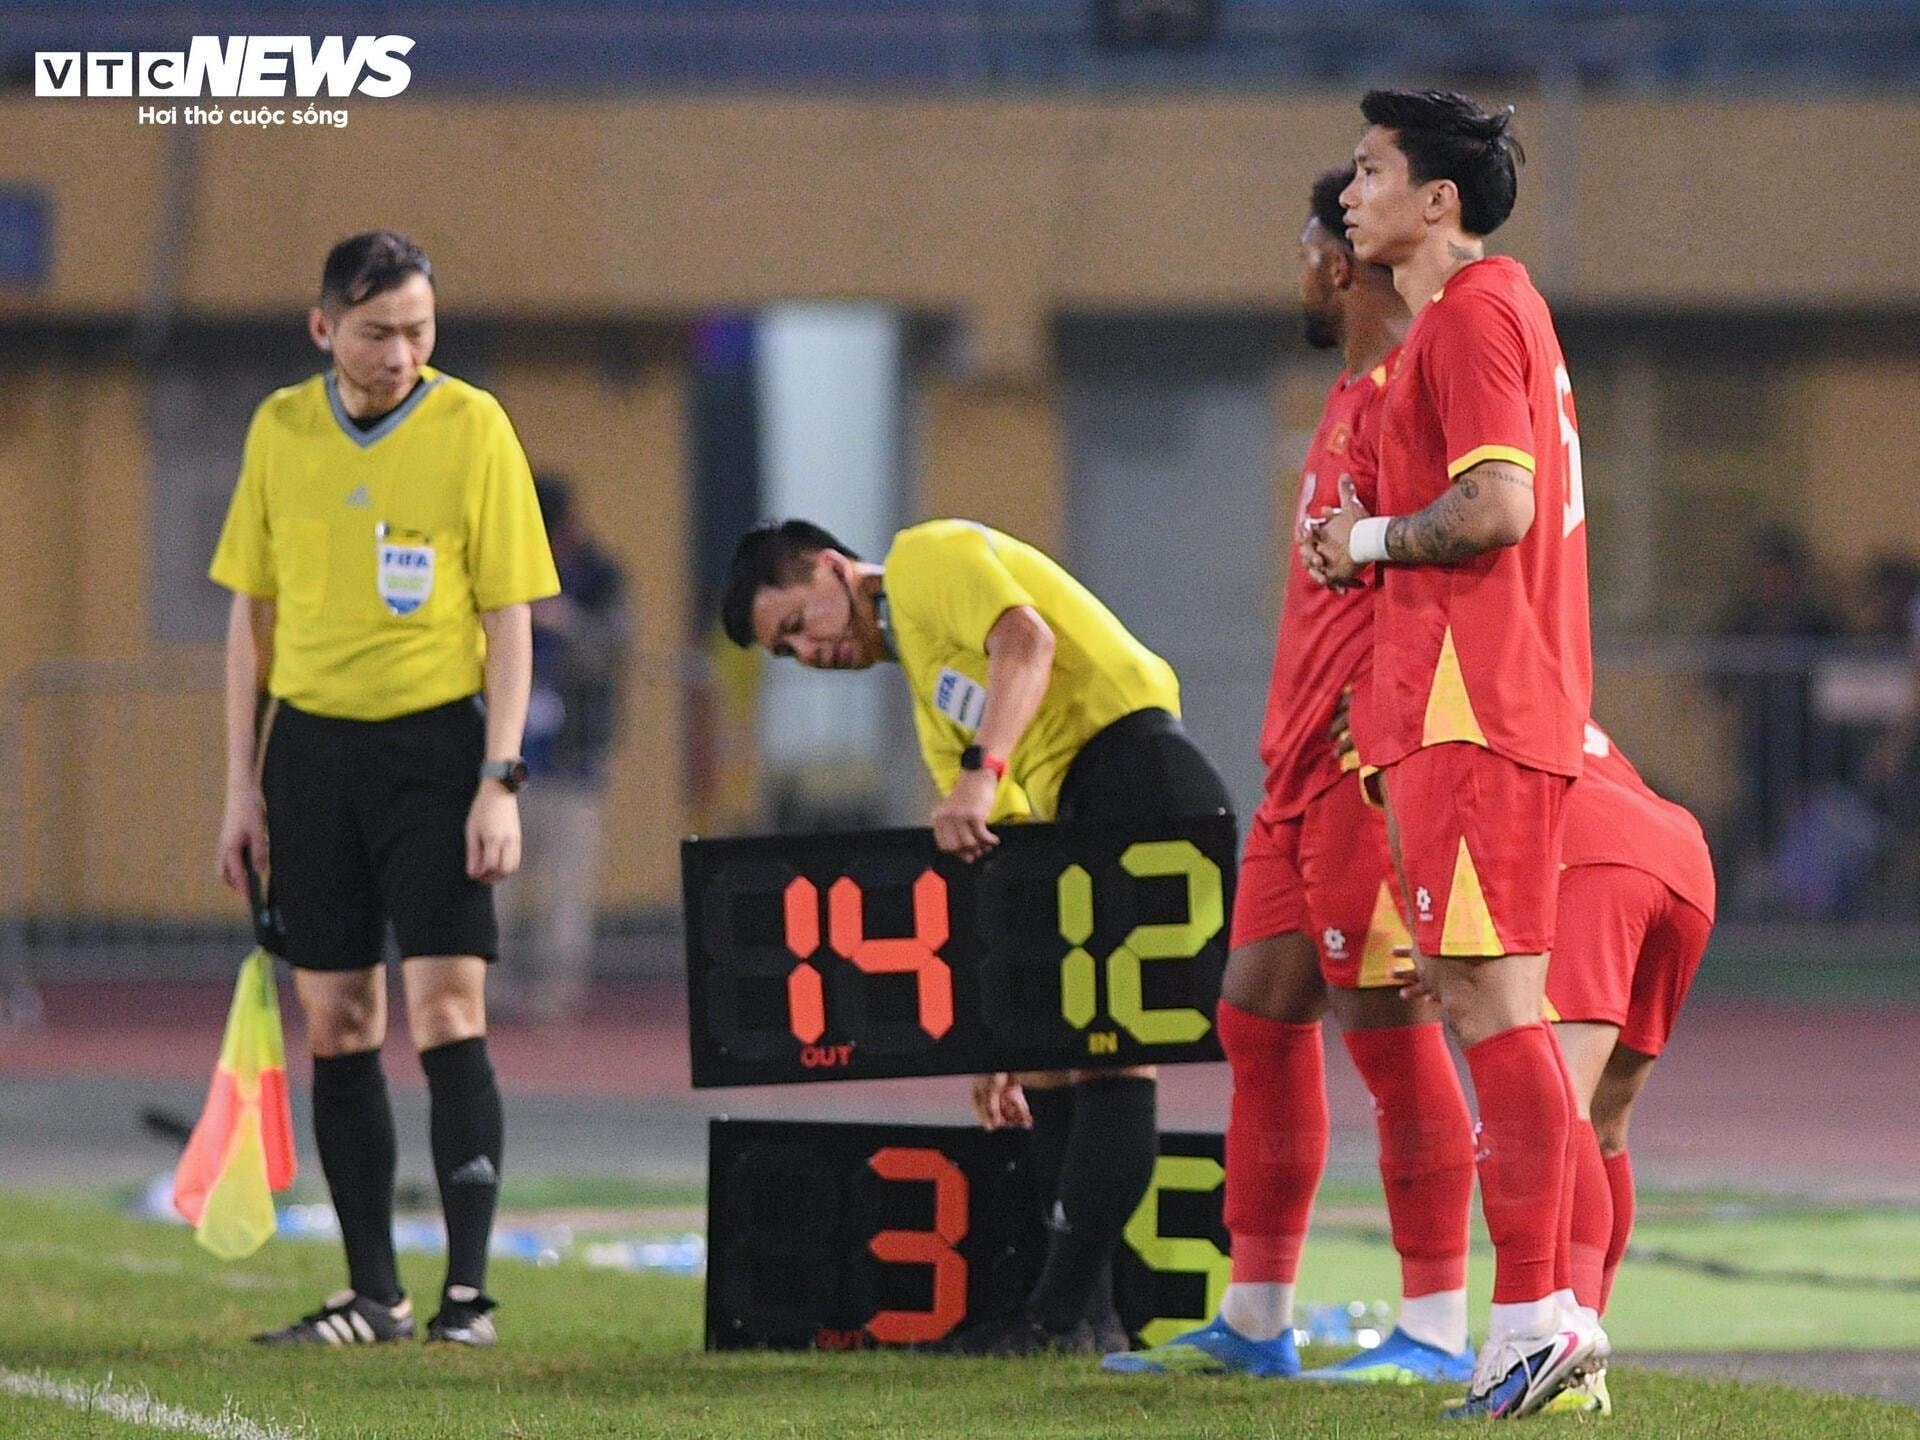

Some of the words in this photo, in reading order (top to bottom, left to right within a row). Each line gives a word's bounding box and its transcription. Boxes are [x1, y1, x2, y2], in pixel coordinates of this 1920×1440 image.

[384, 552, 428, 568] FIFA
[783, 869, 955, 1045] 14
[1057, 839, 1225, 1045] 12
[801, 1045, 854, 1067] OUT
[1088, 1031, 1119, 1055] IN
[865, 1146, 969, 1343] 3
[1123, 1156, 1232, 1349] 5
